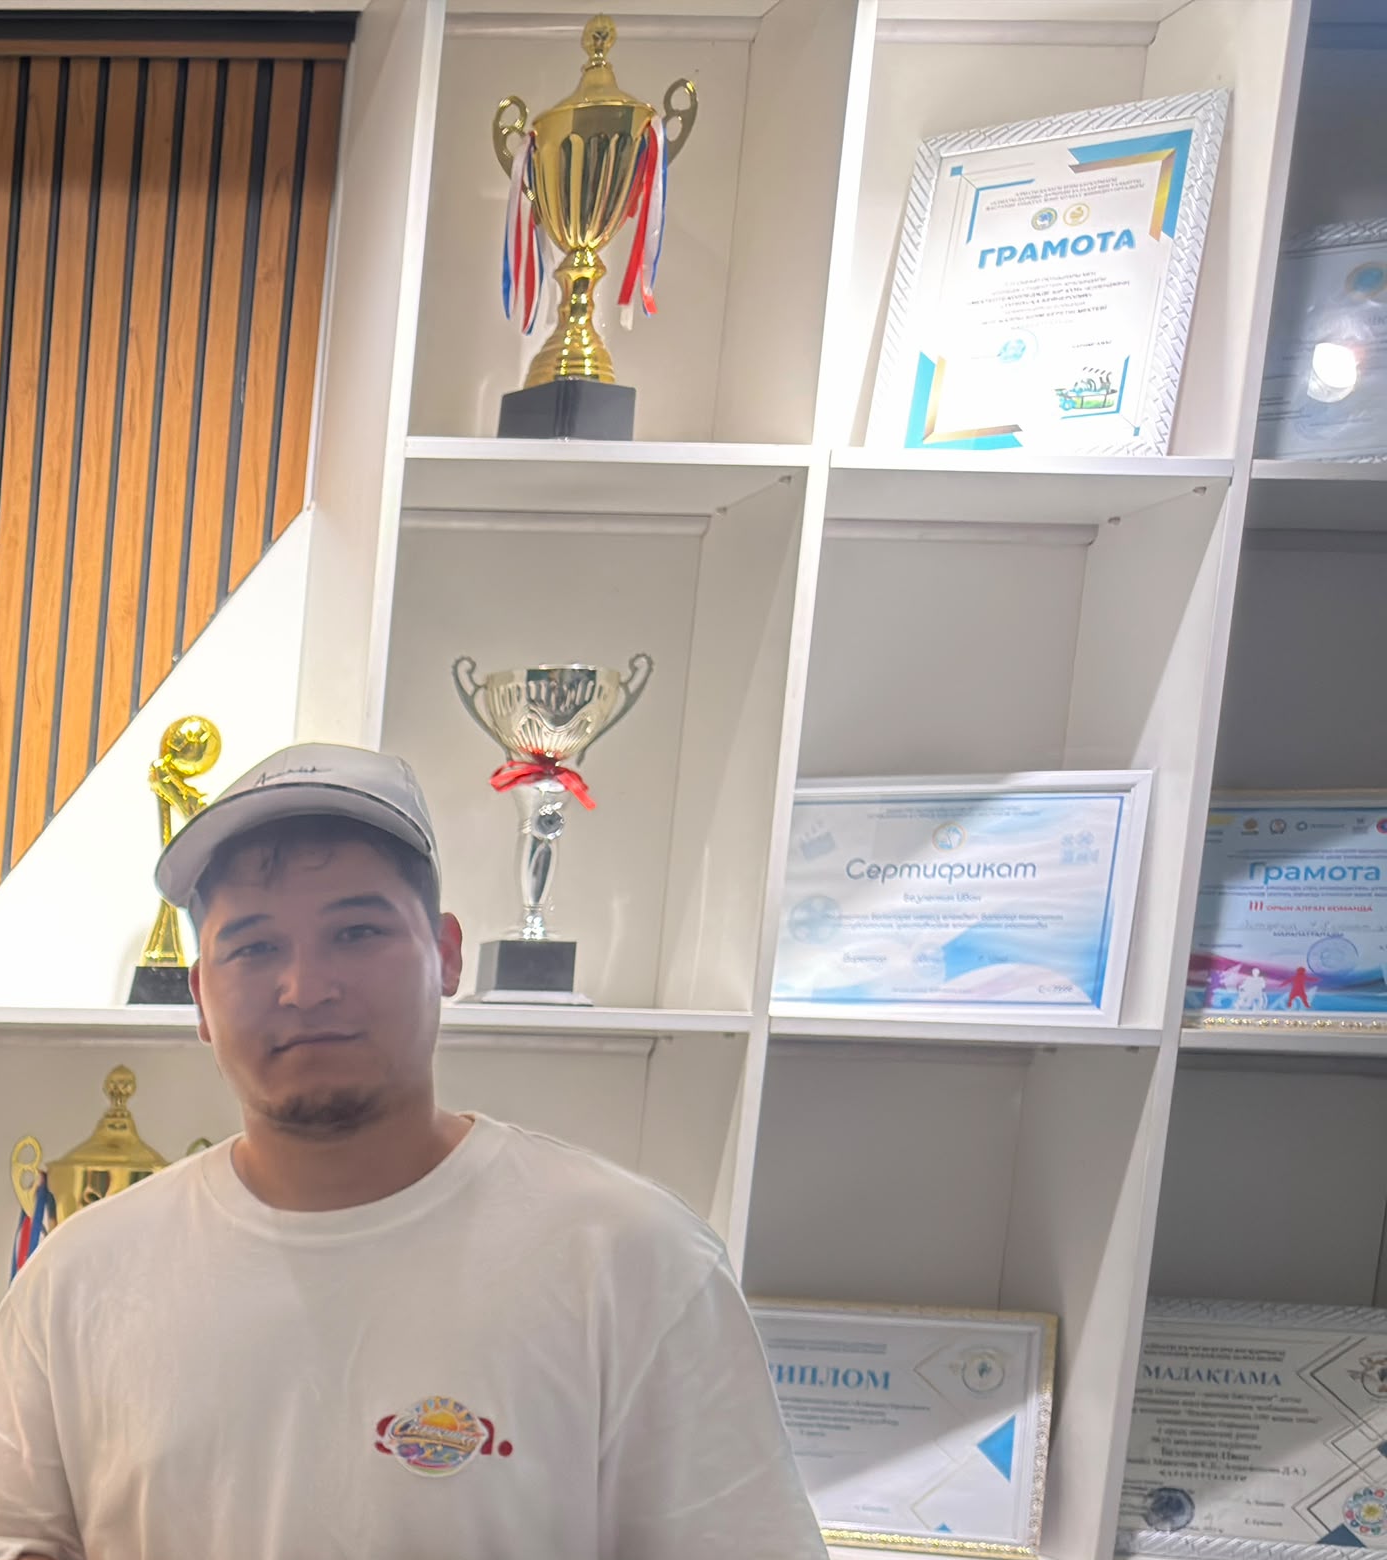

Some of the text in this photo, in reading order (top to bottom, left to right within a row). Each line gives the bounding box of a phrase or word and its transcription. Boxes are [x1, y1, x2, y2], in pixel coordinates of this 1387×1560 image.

[978, 228, 1136, 269] ГРАМОТА
[845, 857, 1038, 885] Сертификат
[1249, 861, 1381, 886] Грамота
[1249, 900, 1264, 912] III
[1143, 1364, 1282, 1387] МАДАҚТАМА
